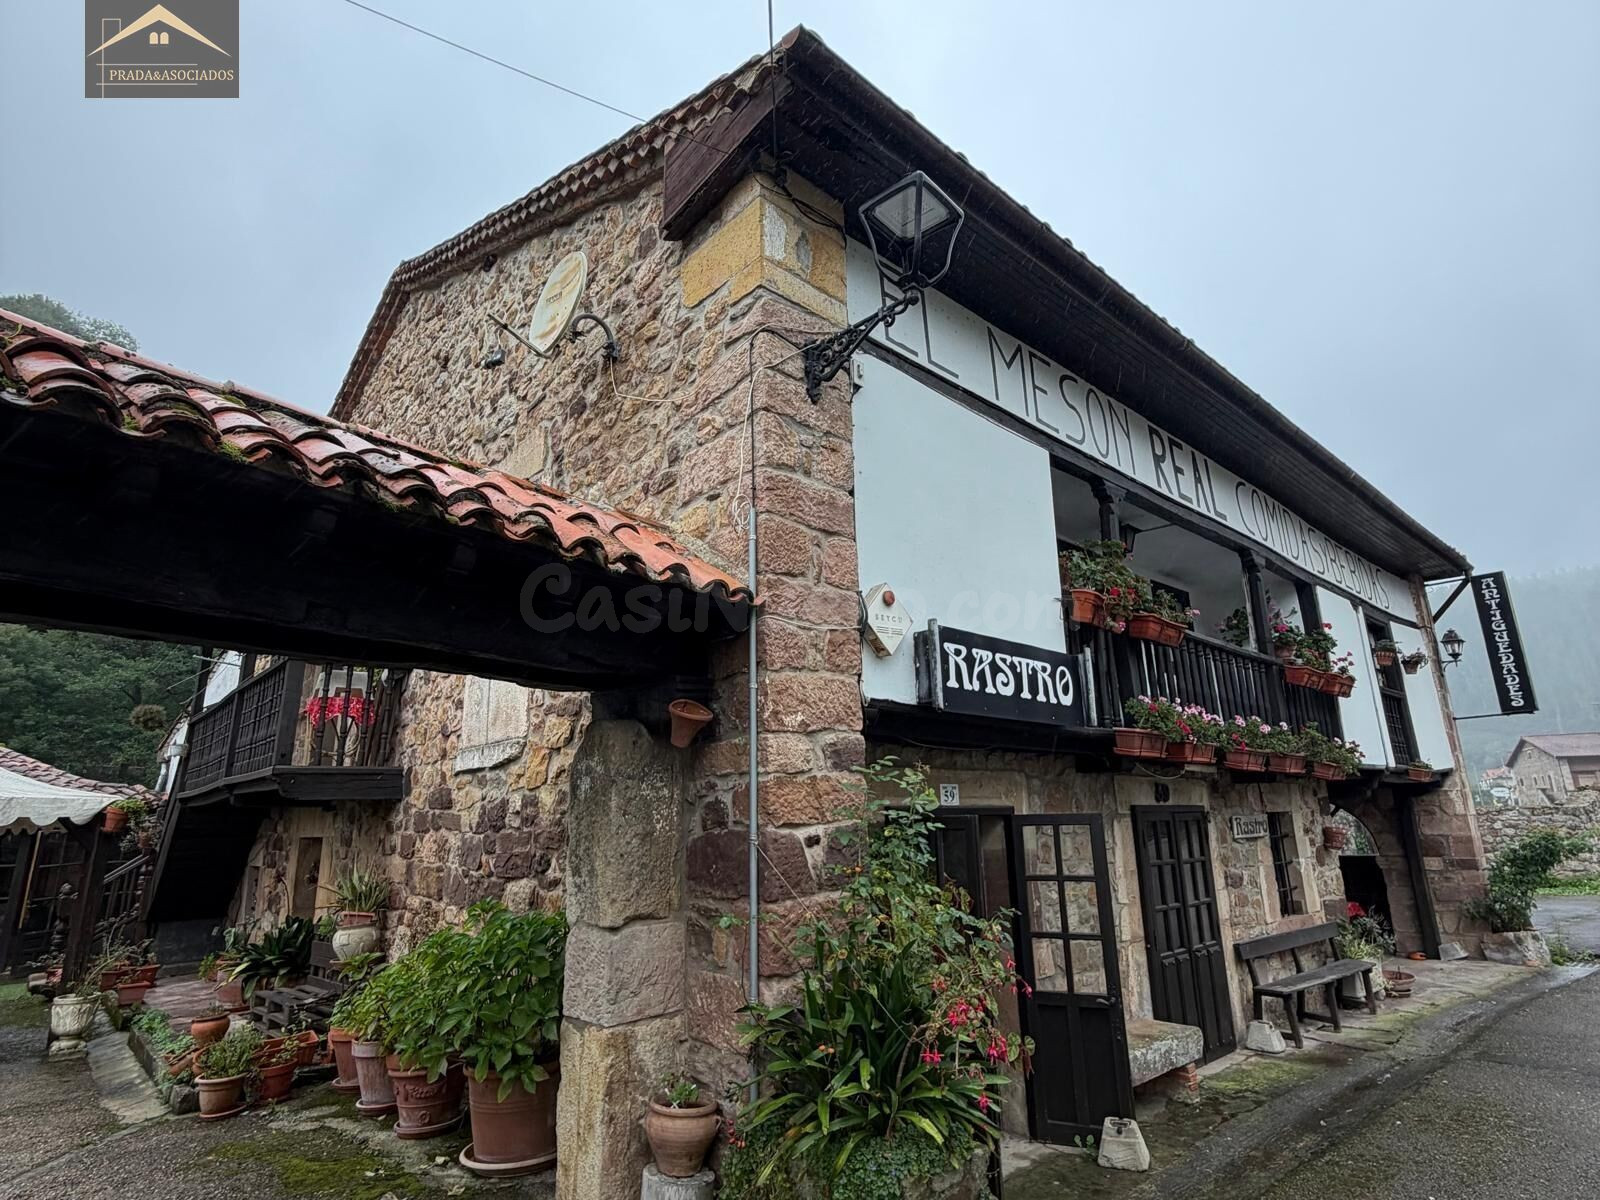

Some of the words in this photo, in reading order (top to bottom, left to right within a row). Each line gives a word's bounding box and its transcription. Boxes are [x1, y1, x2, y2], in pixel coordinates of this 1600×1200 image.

[878, 259, 959, 380] EL
[986, 326, 1137, 475] MESON
[1147, 424, 1228, 522] REAL
[1235, 480, 1325, 575] COMIDAS
[943, 642, 1074, 706] RASTRO
[944, 790, 955, 802] 59
[1234, 817, 1268, 836] Rastro
